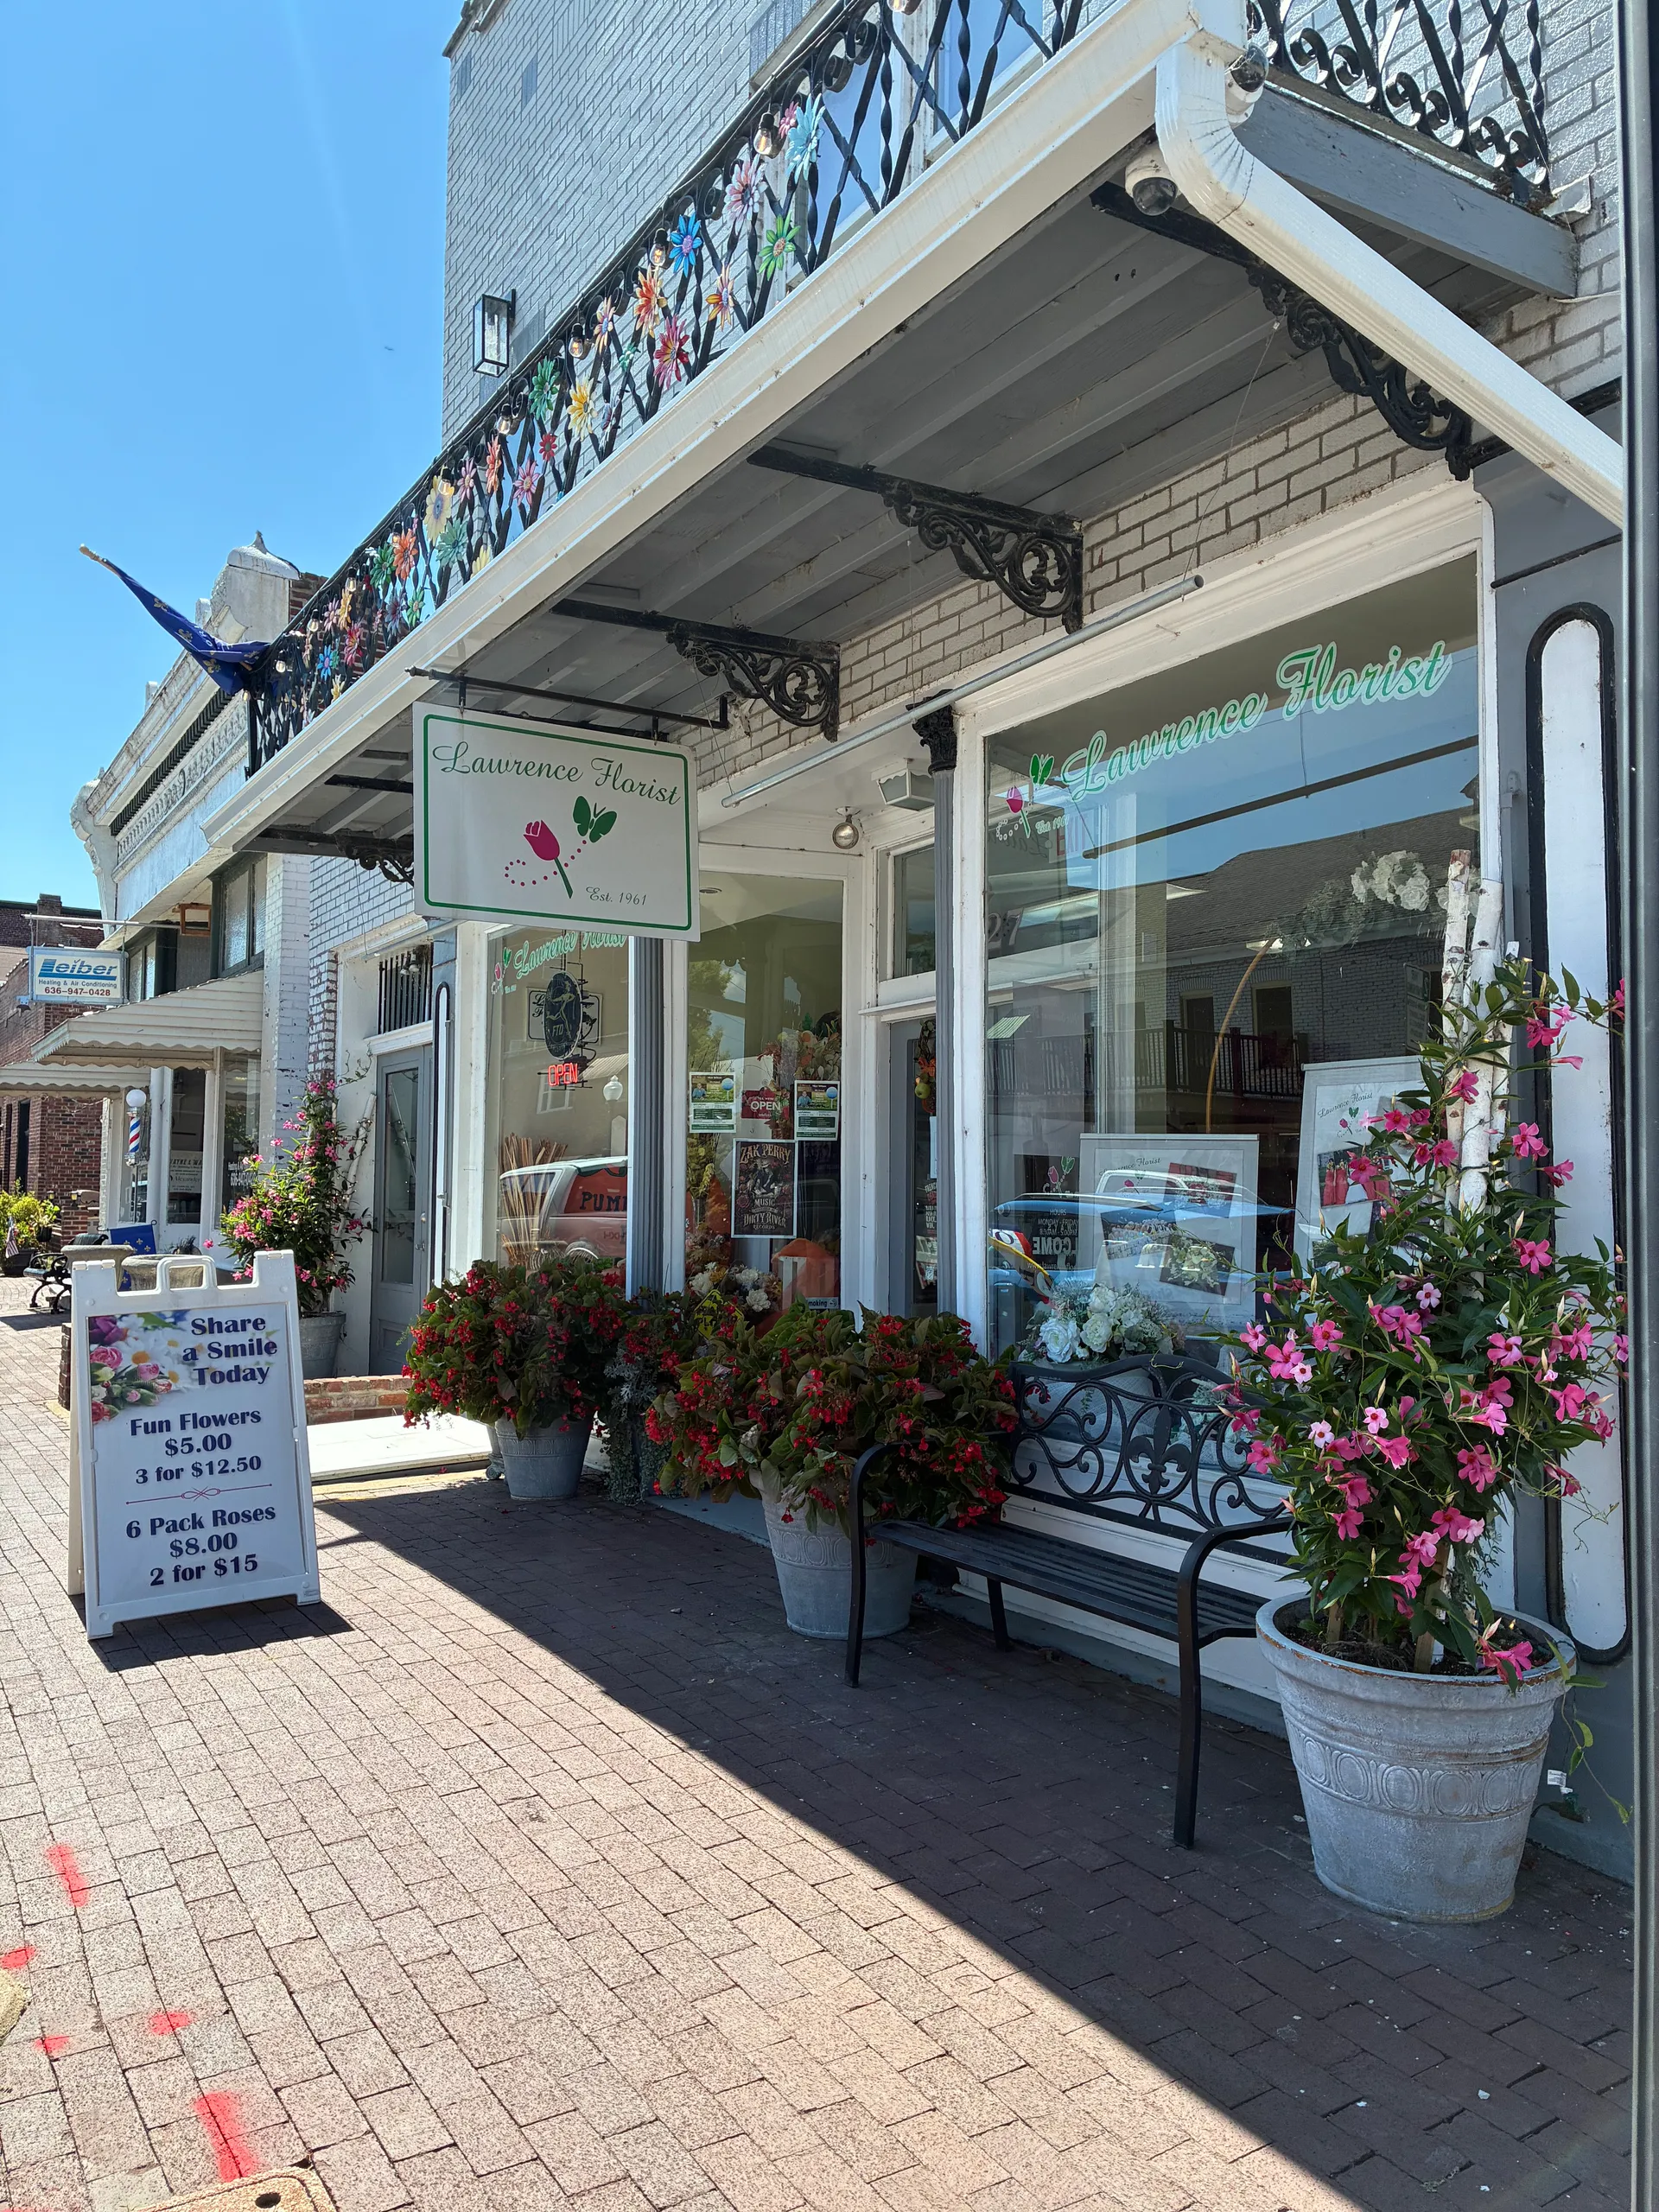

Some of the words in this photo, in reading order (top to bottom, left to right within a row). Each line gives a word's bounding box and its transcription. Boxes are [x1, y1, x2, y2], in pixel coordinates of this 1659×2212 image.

[1061, 692, 1268, 802] Lawrence
[1276, 640, 1452, 721] Florist
[432, 741, 584, 783] Lawrence
[590, 757, 682, 805] Florist
[585, 886, 613, 902] Est.
[619, 892, 647, 906] 1961
[512, 931, 579, 980] Lawrence
[44, 987, 111, 996] 636-947-0428
[81, 981, 118, 989] Conditioning
[552, 1023, 564, 1038] FTD
[547, 1062, 578, 1087] OPEN
[750, 1101, 781, 1111] OPEN
[1318, 1101, 1350, 1119] Lawrence
[1351, 1092, 1373, 1103] Florist
[739, 1143, 760, 1164] ZAK
[761, 1143, 791, 1165] PERRY
[1136, 1157, 1162, 1166] Florist
[754, 1198, 775, 1207] MUSIC
[744, 1212, 765, 1227] DIRTY
[766, 1211, 786, 1229] RIVER
[808, 1300, 828, 1308] moking
[191, 1317, 266, 1336] Share
[182, 1347, 199, 1363] a
[207, 1338, 277, 1360] Smile
[193, 1364, 270, 1385] Today
[130, 1415, 171, 1436] Fun
[180, 1409, 262, 1431] Flowers
[165, 1433, 232, 1458] $5.00
[136, 1469, 149, 1484] 3
[156, 1465, 184, 1482] for
[191, 1456, 262, 1479] $12.50
[126, 1520, 142, 1539] 6
[150, 1511, 204, 1535] Pack
[213, 1506, 276, 1528] Roses
[169, 1531, 238, 1559] $8.00
[149, 1567, 164, 1586] 2
[173, 1565, 206, 1583] for
[214, 1554, 257, 1578] $15
